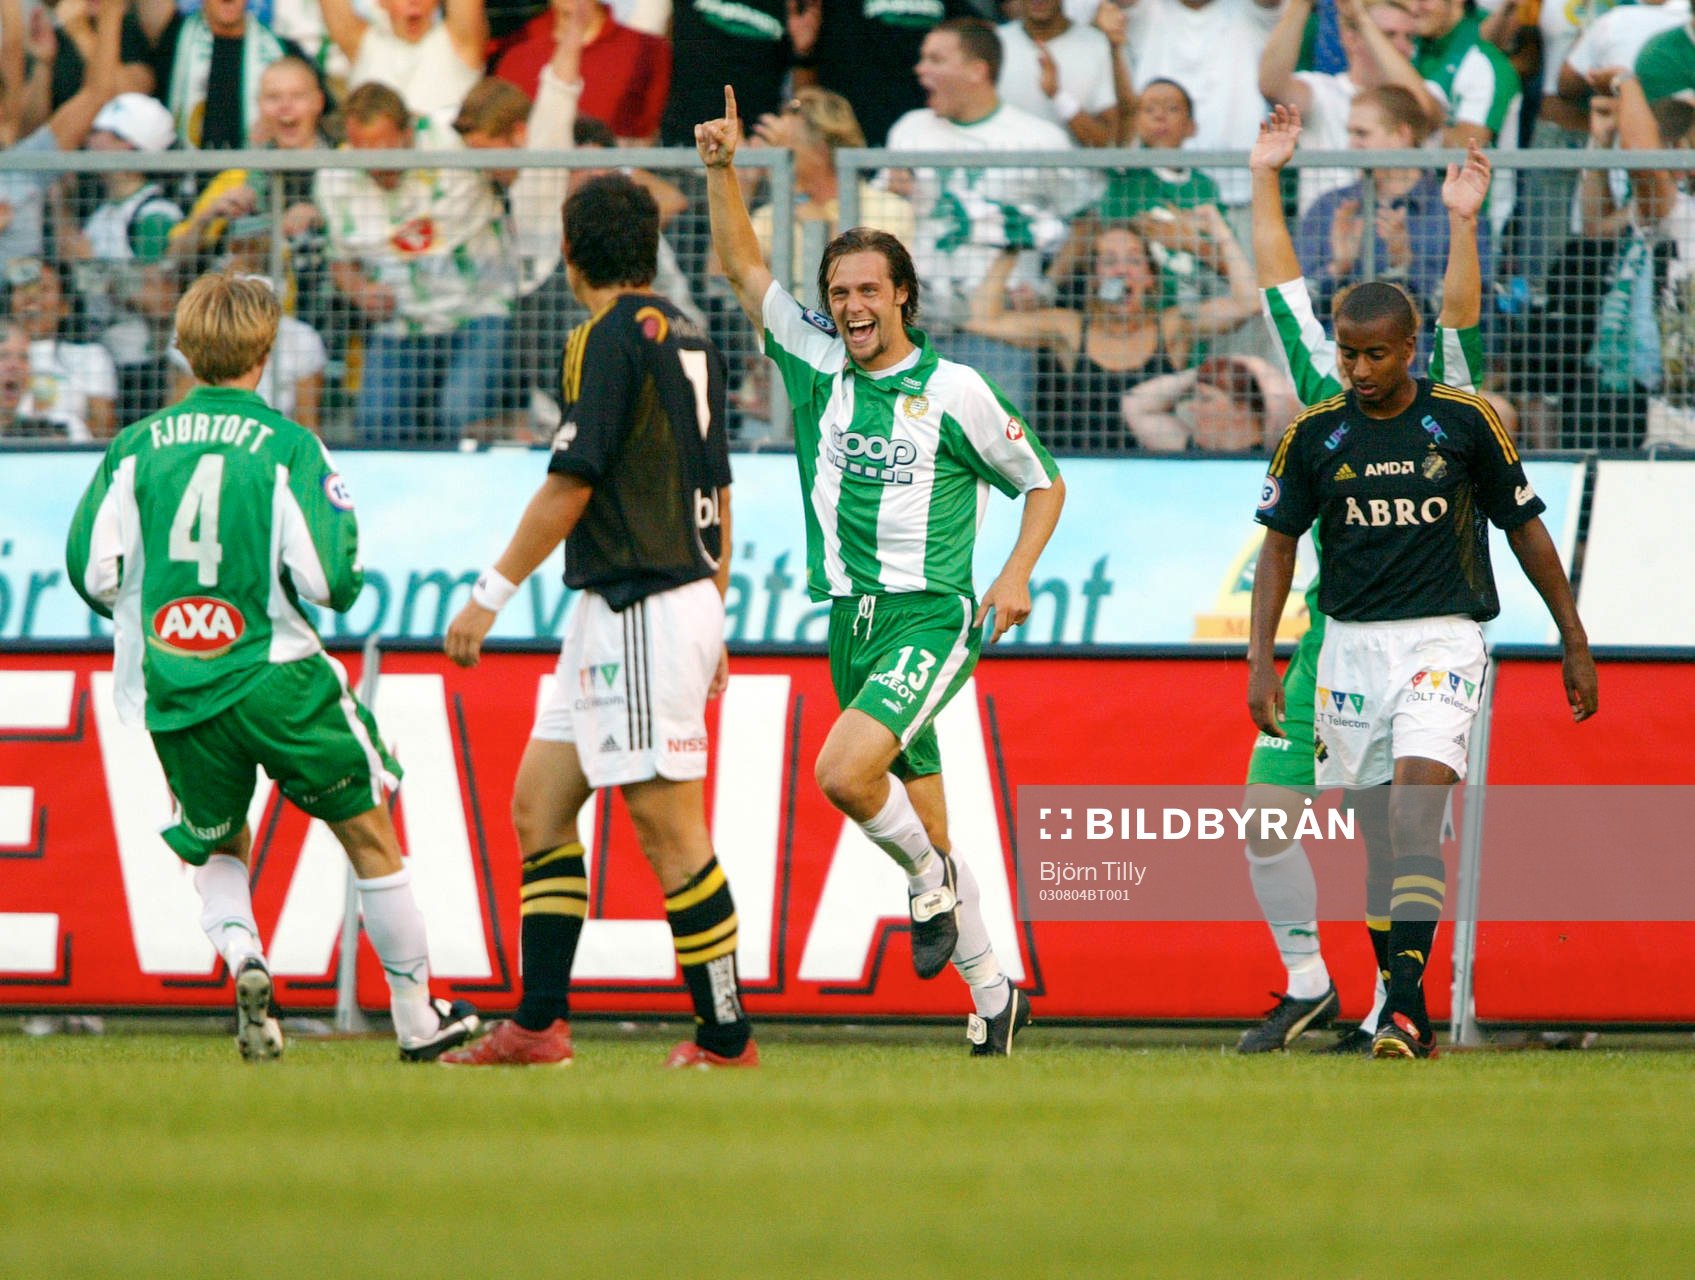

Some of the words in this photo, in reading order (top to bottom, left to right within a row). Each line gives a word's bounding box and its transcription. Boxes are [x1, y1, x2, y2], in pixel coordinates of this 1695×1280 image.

[150, 413, 274, 454] FJØRTOFT
[1324, 421, 1351, 450] UPC
[1421, 414, 1448, 444] UPC
[1365, 461, 1401, 476] AMD
[169, 453, 224, 587] 4
[1345, 496, 1448, 526] ÅBRO
[160, 602, 236, 640] AXA
[887, 645, 937, 691] 13
[1327, 714, 1370, 730] Telecom
